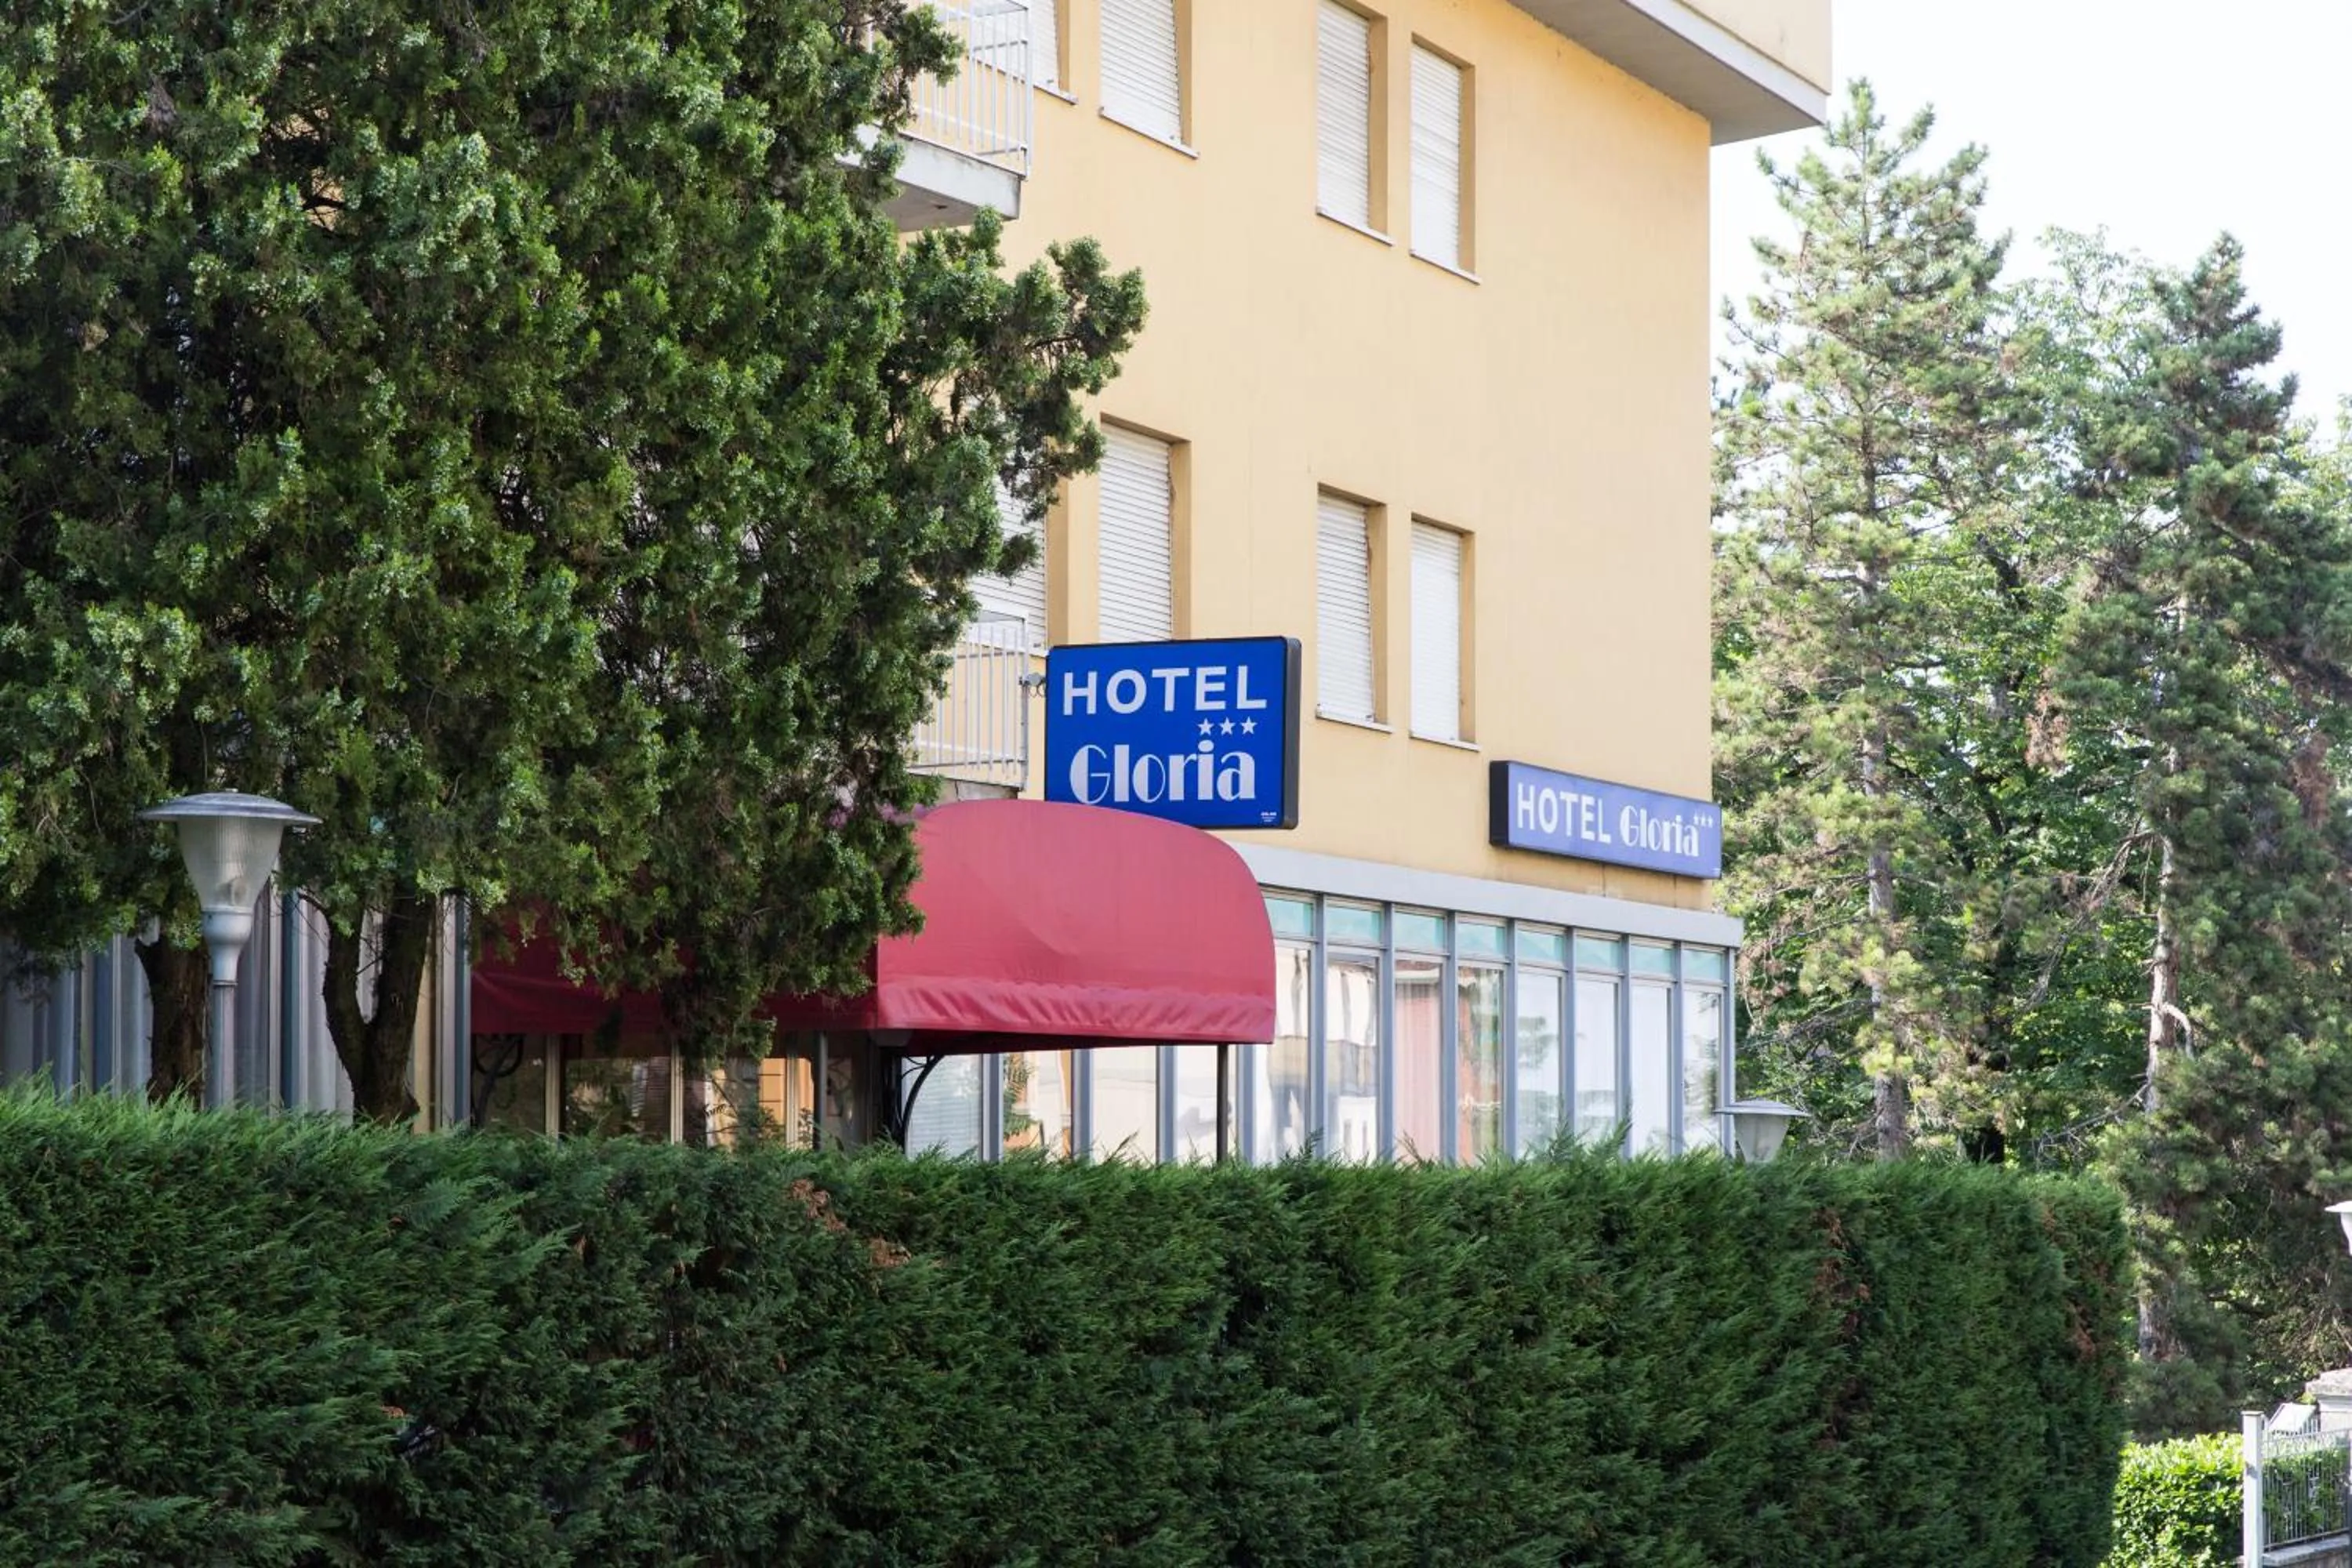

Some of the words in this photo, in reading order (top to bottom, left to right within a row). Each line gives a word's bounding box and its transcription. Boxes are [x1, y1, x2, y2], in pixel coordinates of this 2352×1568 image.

[1062, 665, 1268, 715] HOTEL
[1069, 739, 1256, 804] Gloria
[1517, 782, 1611, 844] HOTEL
[1619, 805, 1700, 857] Gloria
